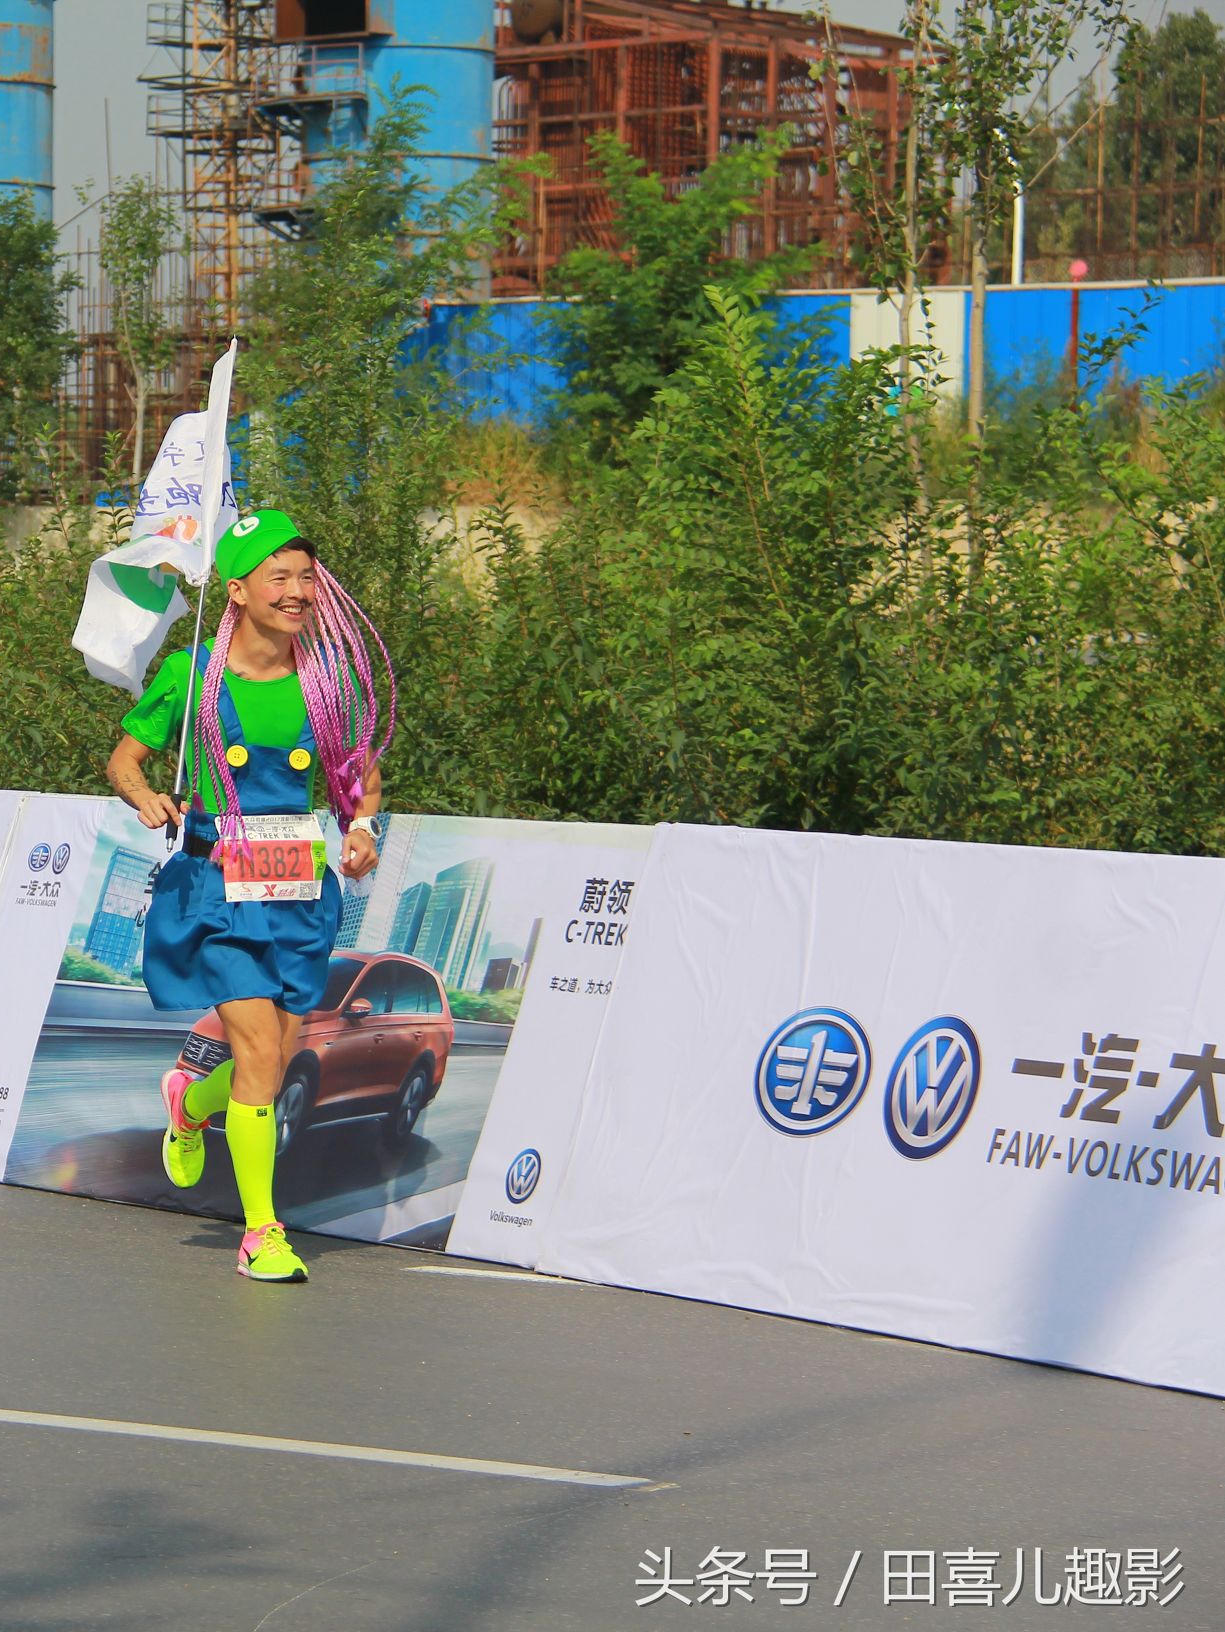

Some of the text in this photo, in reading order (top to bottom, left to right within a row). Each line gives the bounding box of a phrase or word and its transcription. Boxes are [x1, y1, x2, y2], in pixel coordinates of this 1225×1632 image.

[239, 522, 255, 532] L
[579, 878, 634, 914] 蔚领
[564, 920, 629, 947] C-TREK
[986, 1127, 1225, 1195] FAW-VOLKSWA
[489, 1210, 533, 1227] Volkswagen
